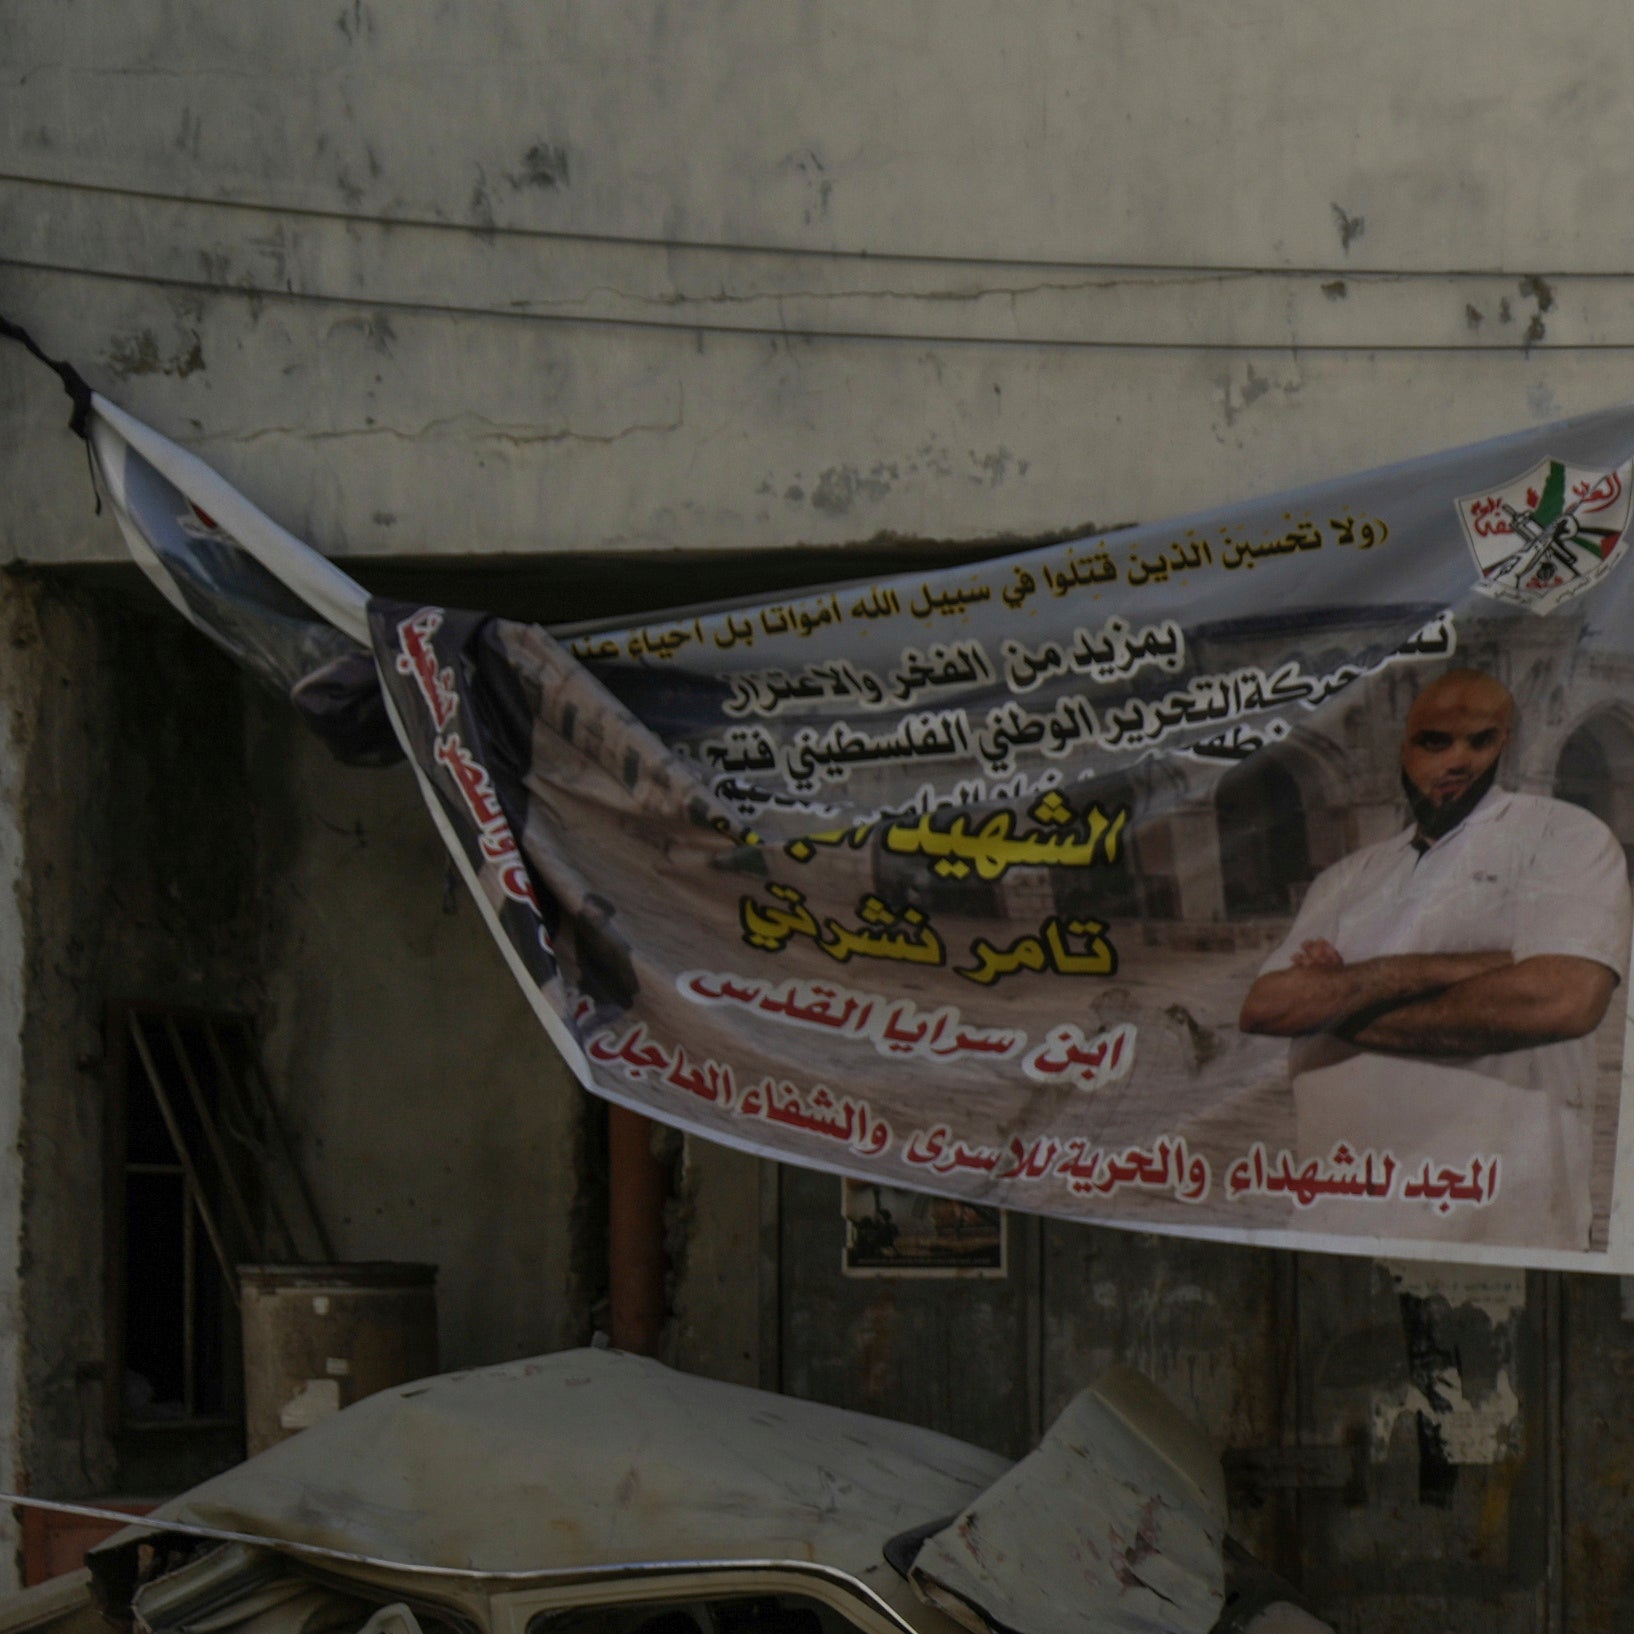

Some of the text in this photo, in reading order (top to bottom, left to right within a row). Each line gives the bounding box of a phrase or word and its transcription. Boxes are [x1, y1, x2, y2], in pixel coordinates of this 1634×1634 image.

[894, 646, 990, 700] الفخر
[1006, 643, 1061, 685] من
[1072, 624, 1177, 677] بمزيد
[980, 701, 1093, 771] الوطني
[1105, 673, 1243, 745] التحرير
[786, 708, 969, 791] الفلسطيني
[886, 790, 1129, 881] الشهيد
[738, 882, 1118, 986] تامر نشرتي
[689, 974, 1126, 1080] ابن سرايا القدس
[589, 1024, 734, 1104] العاجل
[740, 1076, 888, 1154] والشفاء
[1065, 1140, 1203, 1198] والحرية
[1230, 1142, 1396, 1207] للشهداء
[1403, 1152, 1498, 1213] المجد
